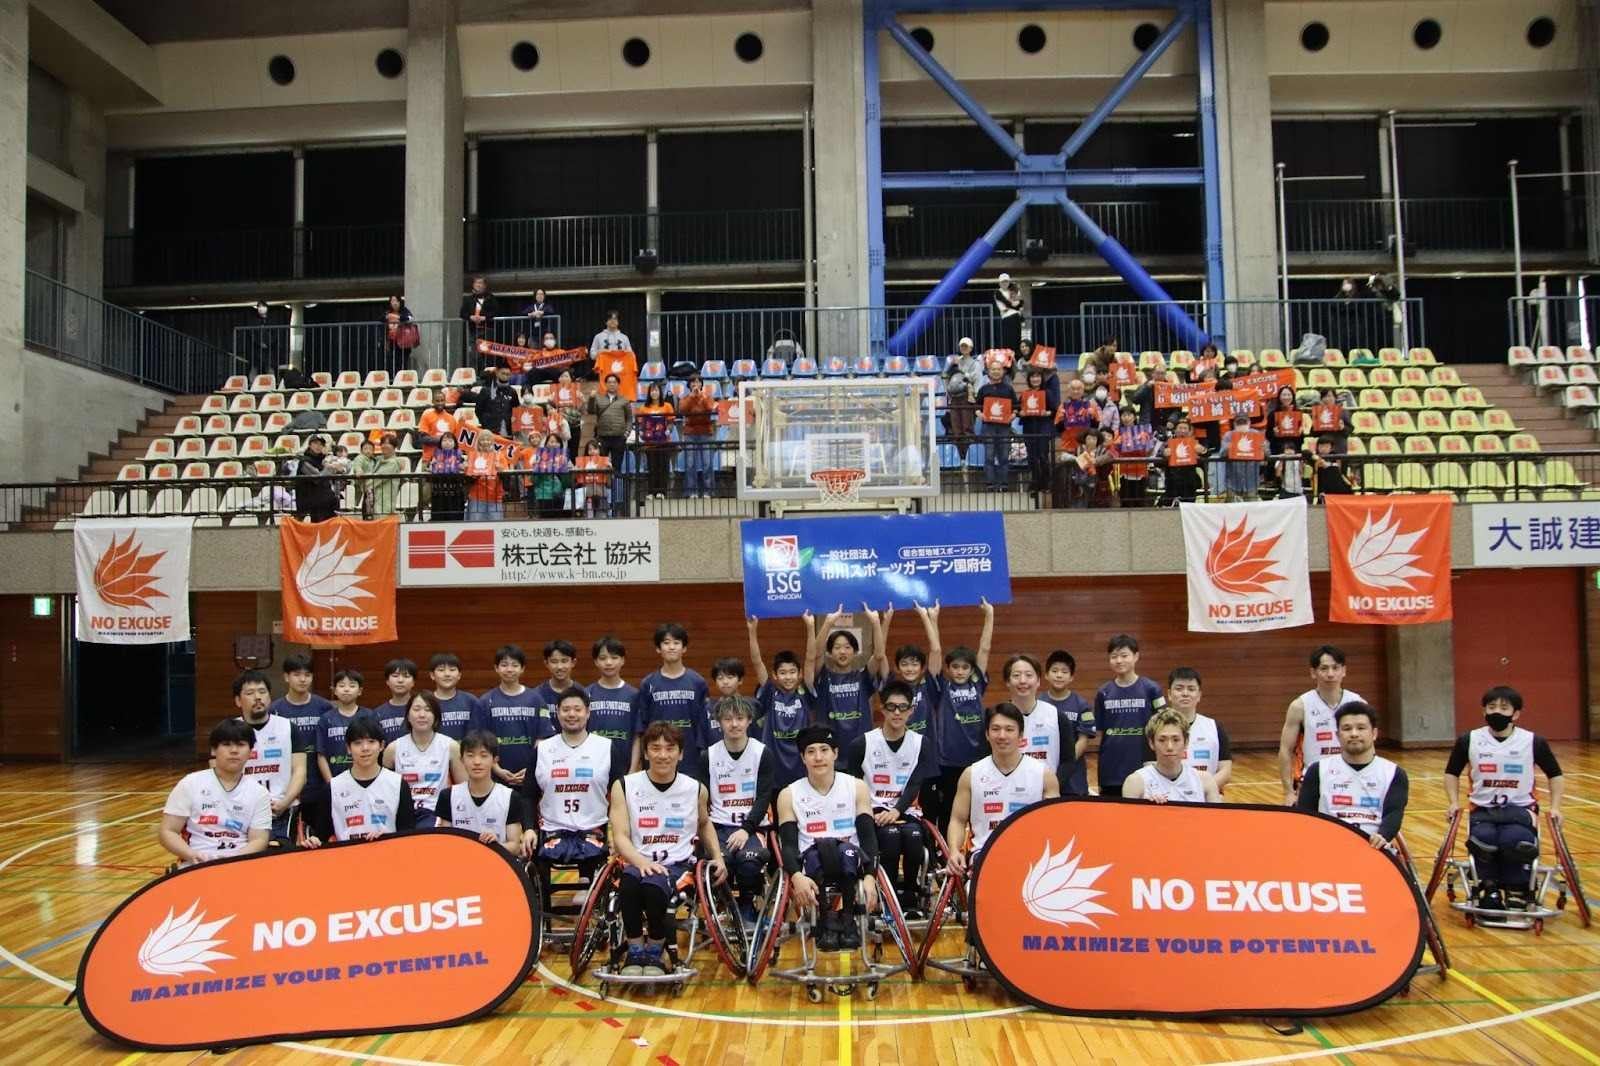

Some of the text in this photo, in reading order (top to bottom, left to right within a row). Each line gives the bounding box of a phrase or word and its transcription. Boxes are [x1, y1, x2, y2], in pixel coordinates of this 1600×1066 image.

[1488, 516, 1600, 551] 大誠建
[501, 540, 651, 568] 株式会社 協栄
[819, 548, 878, 561] 一般社団法人
[501, 566, 628, 582] http://www.k-bm.co.jp
[766, 571, 802, 593] ISG
[1208, 599, 1294, 618] NO EXCUSE
[1348, 595, 1435, 611] NO EXCUSE
[91, 616, 172, 630] NO EXCUSE
[296, 615, 379, 631] NO EXCUSE
[564, 800, 580, 813] 55
[1132, 878, 1365, 914] NO EXCUSE
[253, 895, 483, 951] NO EXCUSE
[1022, 935, 1376, 954] MAXIMIZE YOUR POTENTIAL
[130, 951, 489, 1002] MAXIMIZE YOUR POTENTIAL
